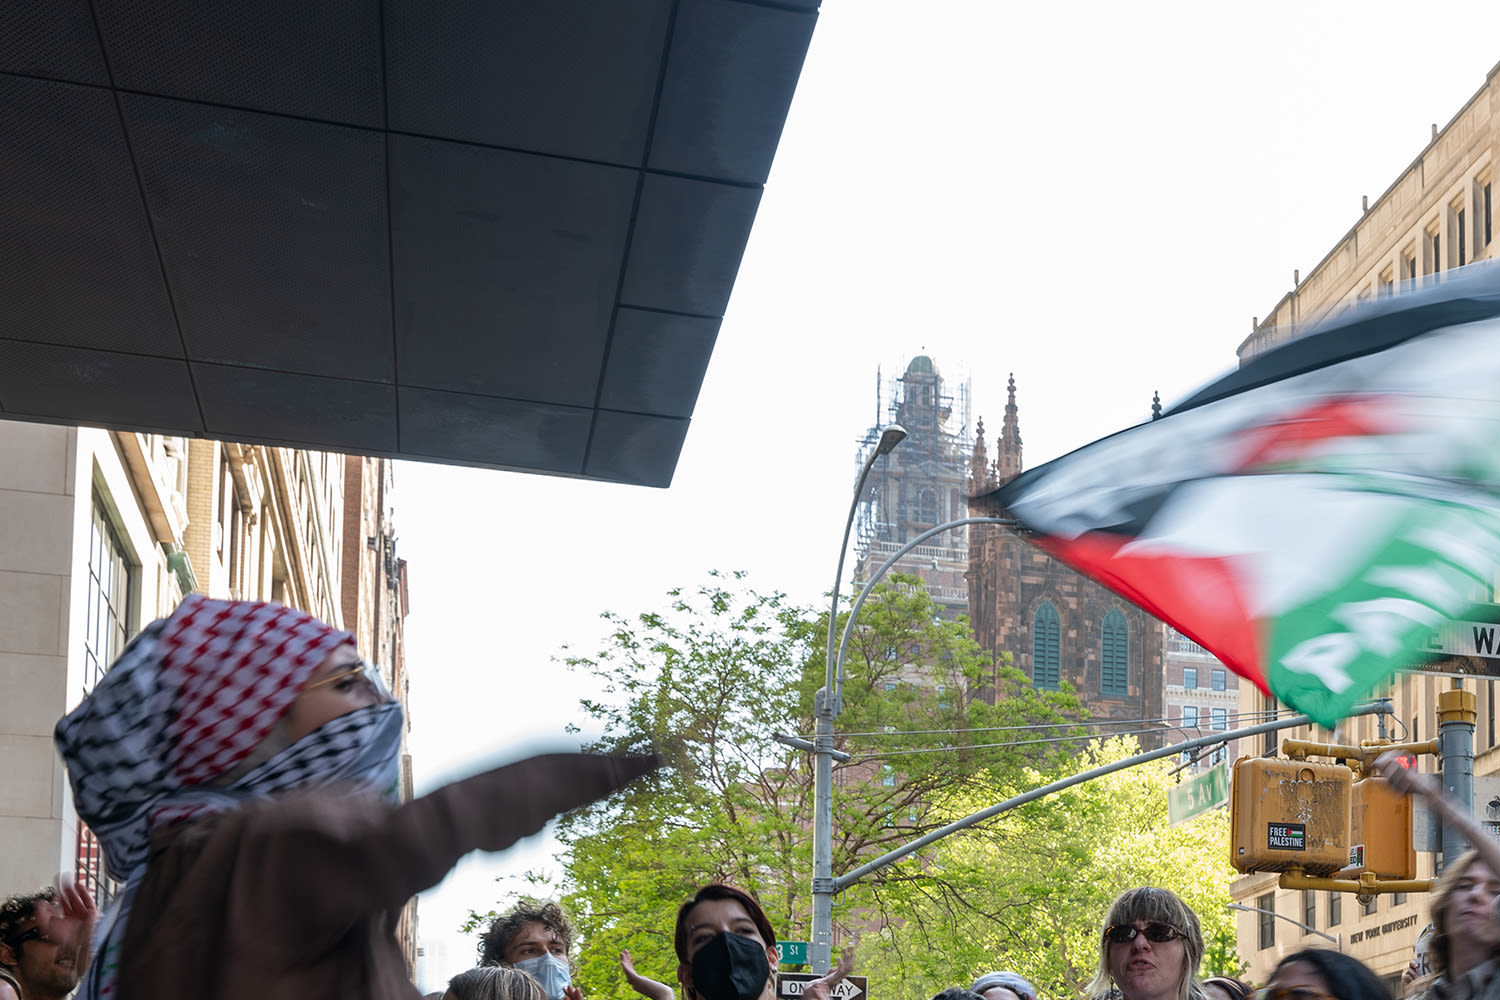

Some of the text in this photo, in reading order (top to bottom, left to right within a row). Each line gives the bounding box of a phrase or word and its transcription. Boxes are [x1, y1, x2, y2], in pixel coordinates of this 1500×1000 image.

[1187, 787, 1195, 810] 5
[1269, 827, 1287, 837] FREE
[1269, 838, 1303, 847] PALESTINE
[1350, 913, 1418, 945] NEW YORK UNIVERSITY
[789, 944, 799, 955] St
